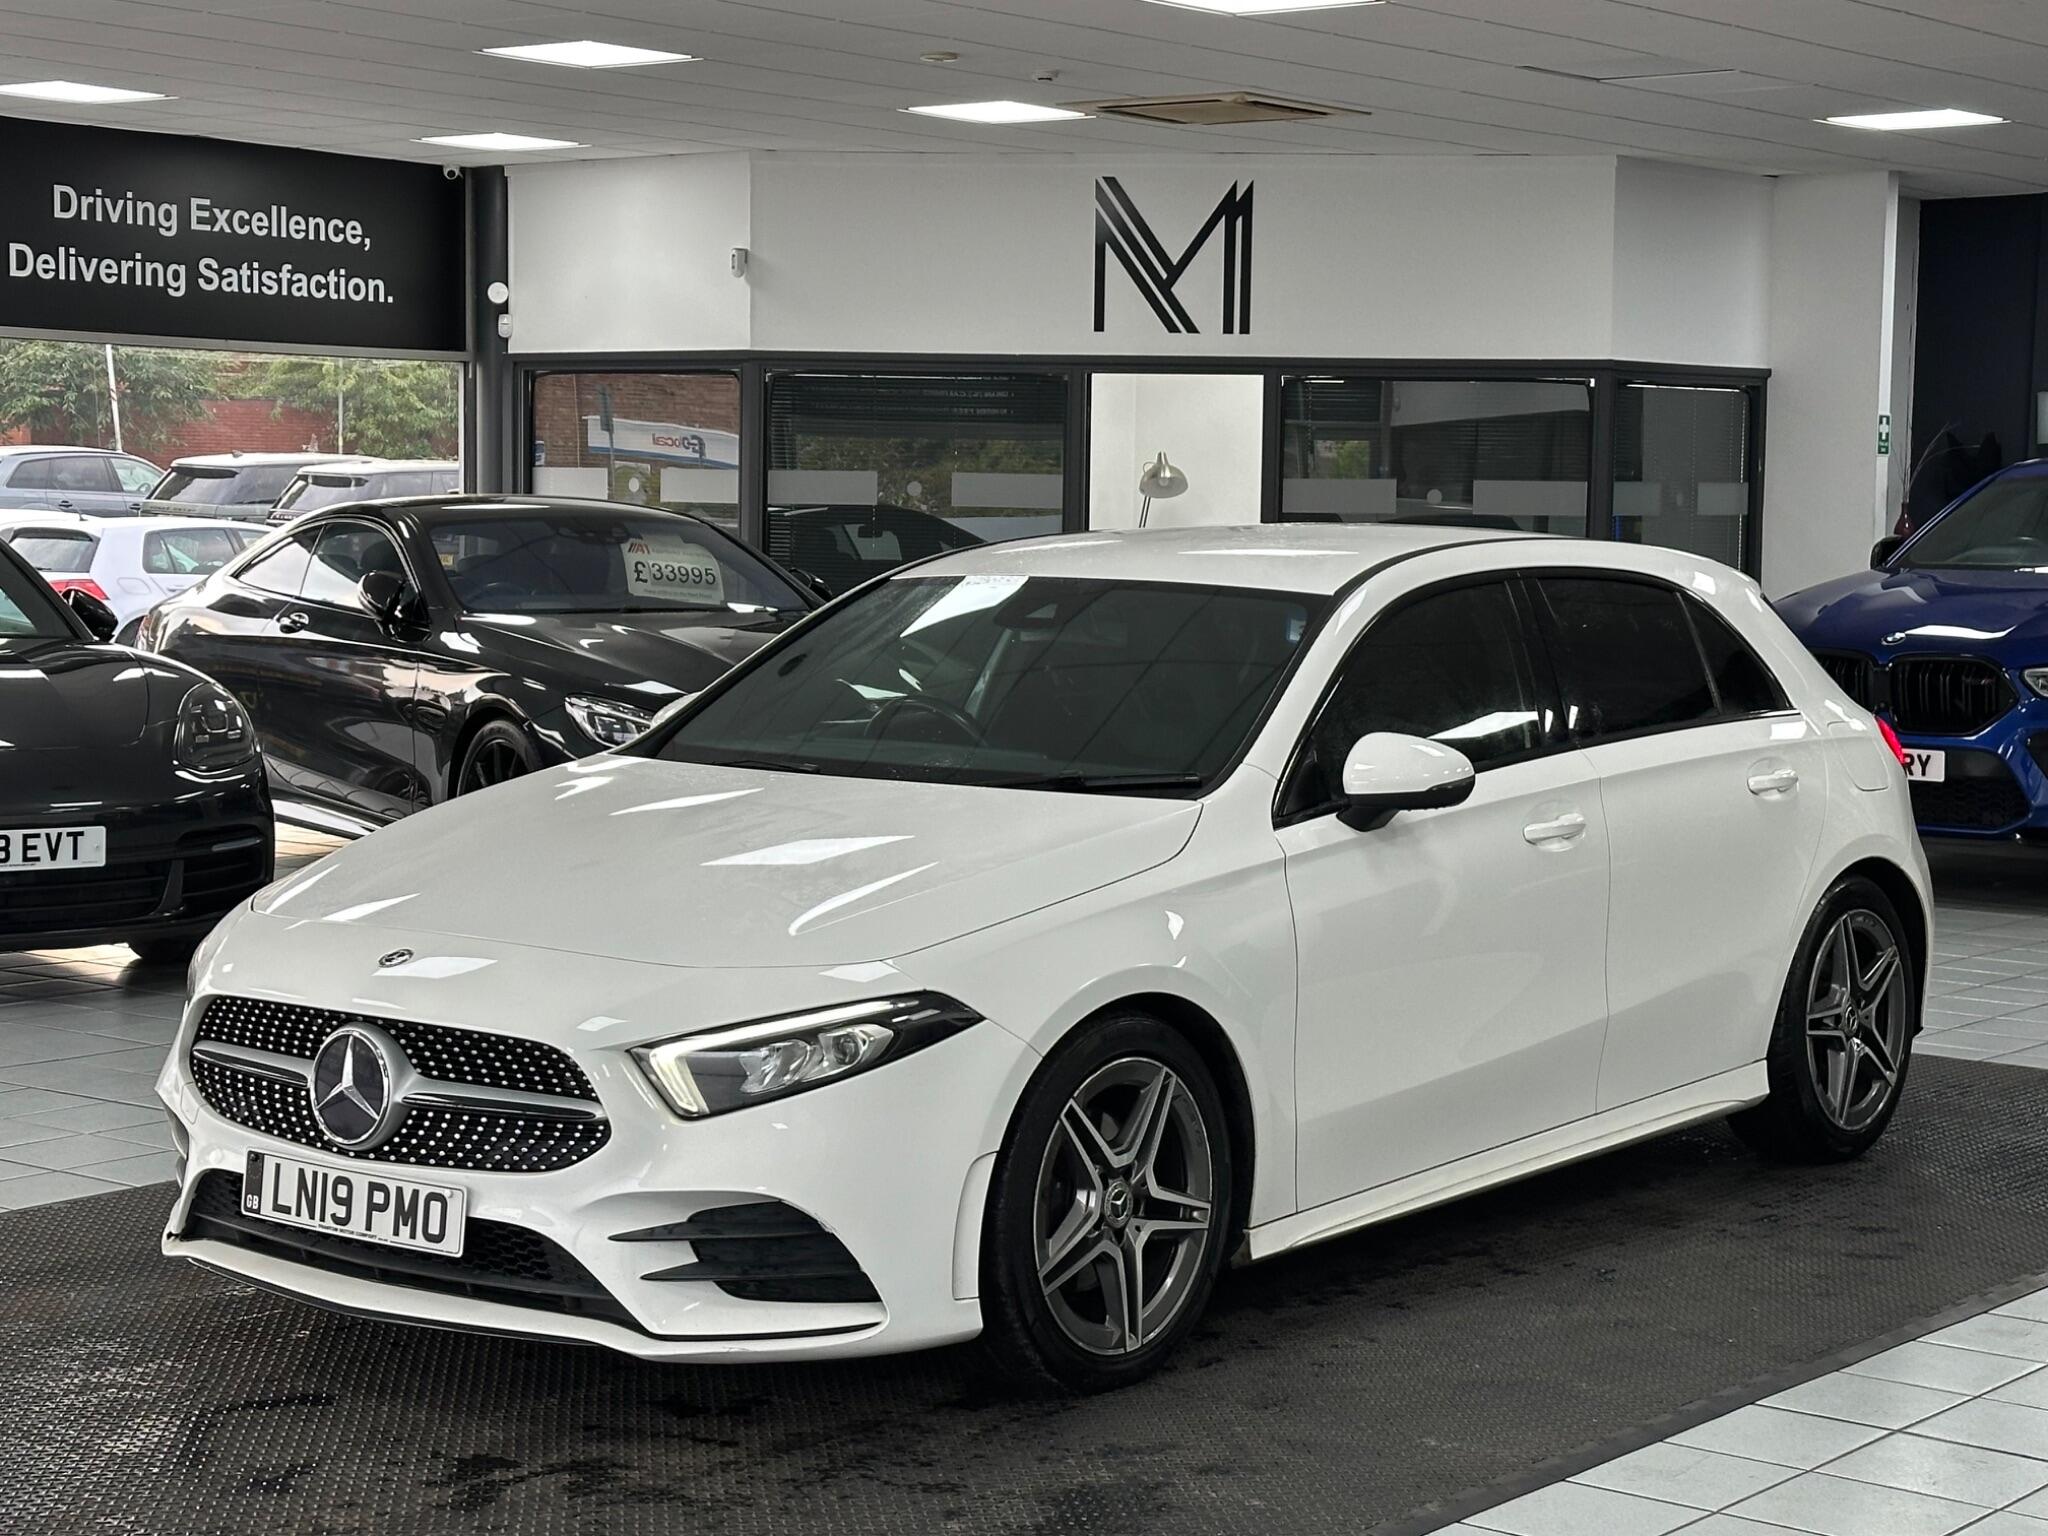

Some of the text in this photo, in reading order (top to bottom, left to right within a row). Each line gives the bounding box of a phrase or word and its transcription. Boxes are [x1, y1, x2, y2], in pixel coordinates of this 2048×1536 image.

[53, 184, 371, 251] Driving Excellence,
[8, 242, 394, 303] Delivering Satisfaction.
[22, 830, 84, 863] EVT
[246, 1194, 259, 1209] GB
[272, 1162, 353, 1226] LN19
